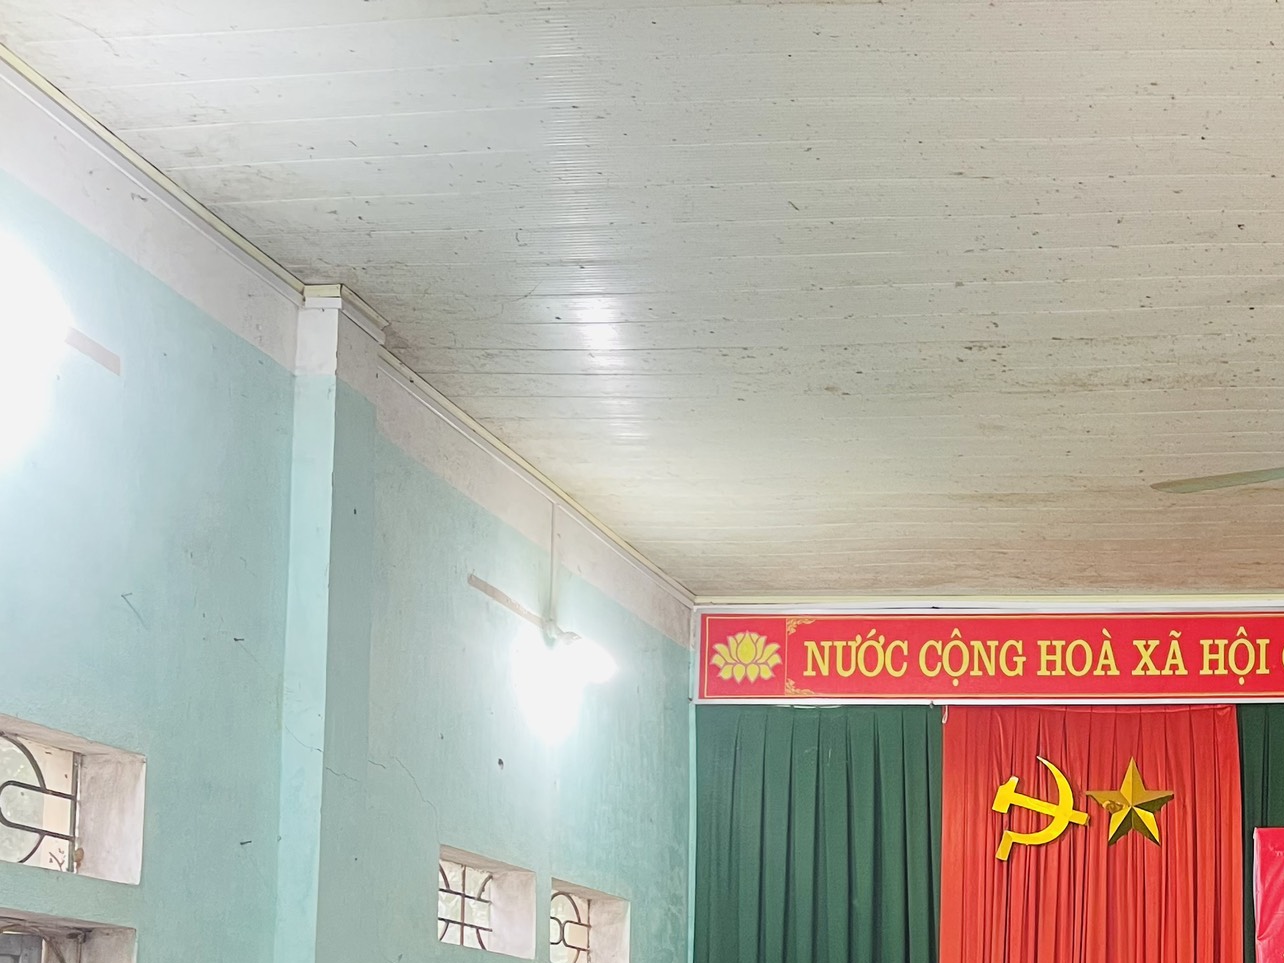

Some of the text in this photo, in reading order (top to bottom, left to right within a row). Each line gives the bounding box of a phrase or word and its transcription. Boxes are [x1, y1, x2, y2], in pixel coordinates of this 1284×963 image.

[803, 634, 908, 677] NƯỚC
[919, 628, 1025, 687] CỘNG
[1038, 627, 1120, 677] HOÀ
[1132, 630, 1189, 676] XÃ
[1200, 626, 1270, 685] HỘI
